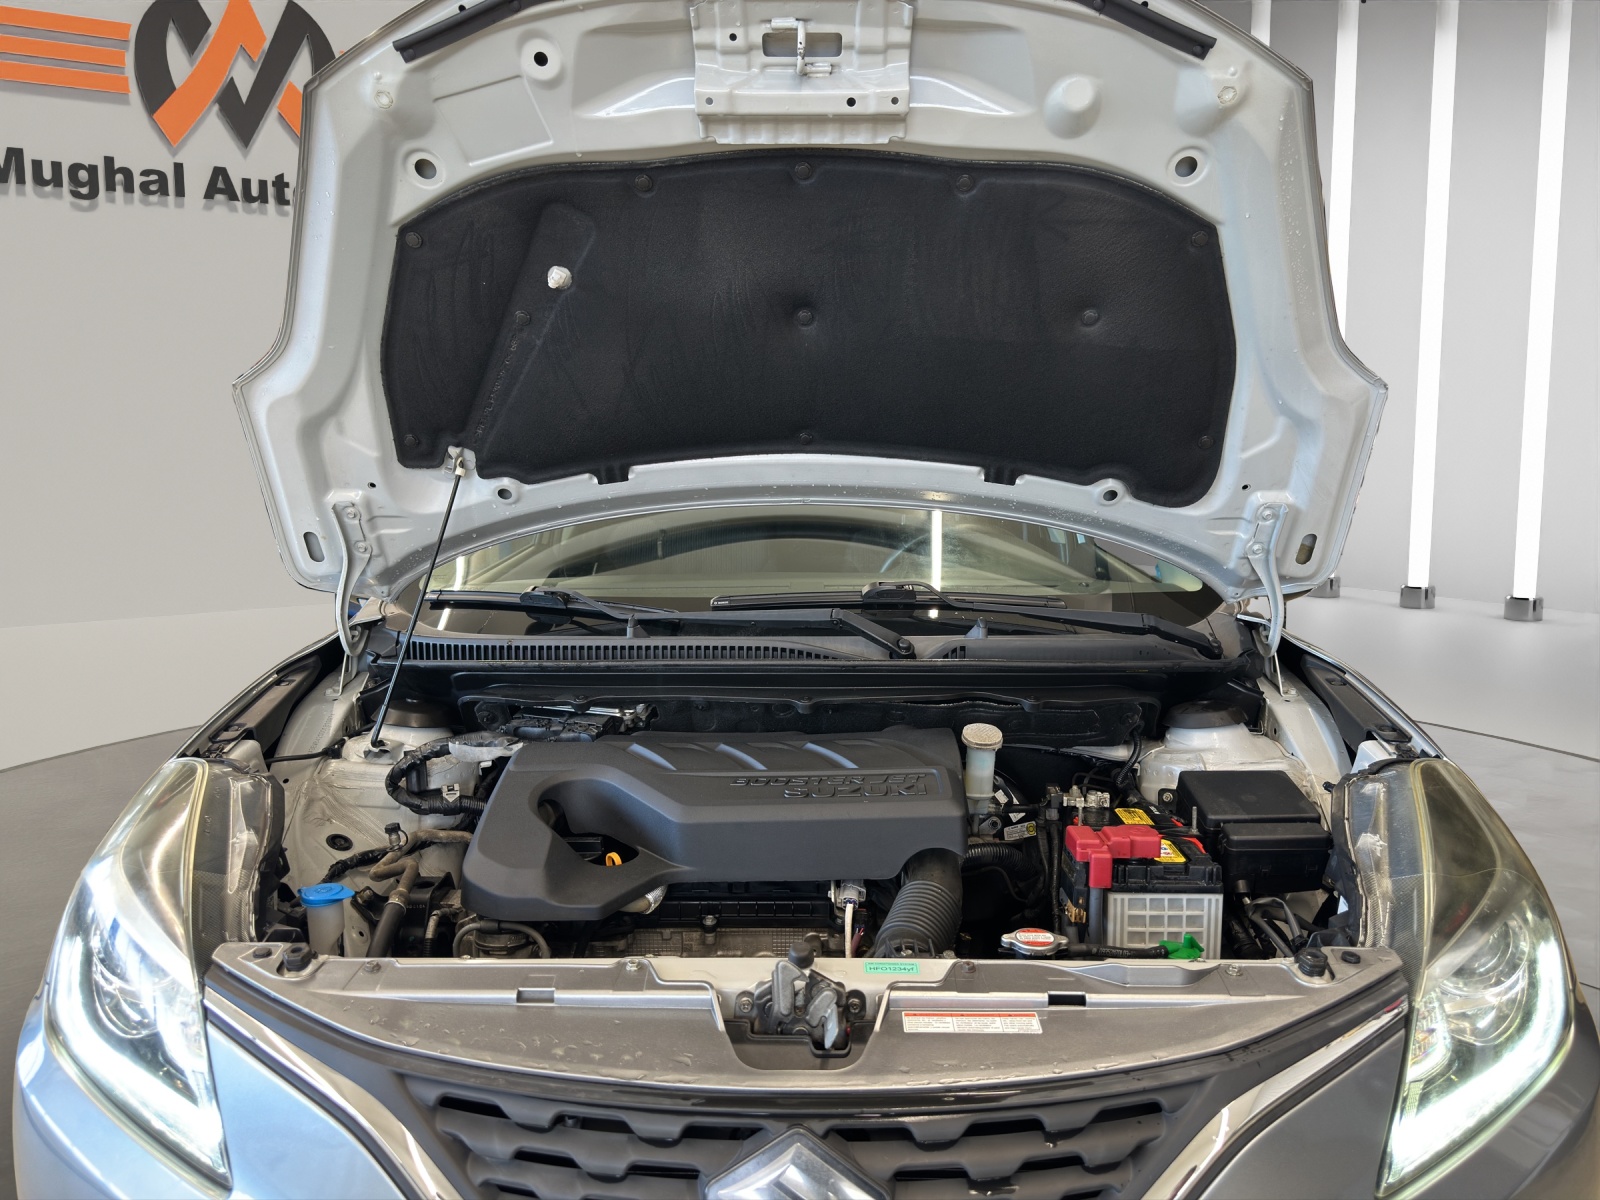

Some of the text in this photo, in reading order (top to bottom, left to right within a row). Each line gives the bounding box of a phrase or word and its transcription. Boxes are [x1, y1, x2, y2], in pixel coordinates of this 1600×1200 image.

[0, 147, 296, 206] Mughal Aut
[869, 774, 926, 784] JET
[783, 783, 927, 798] SUZUKI
